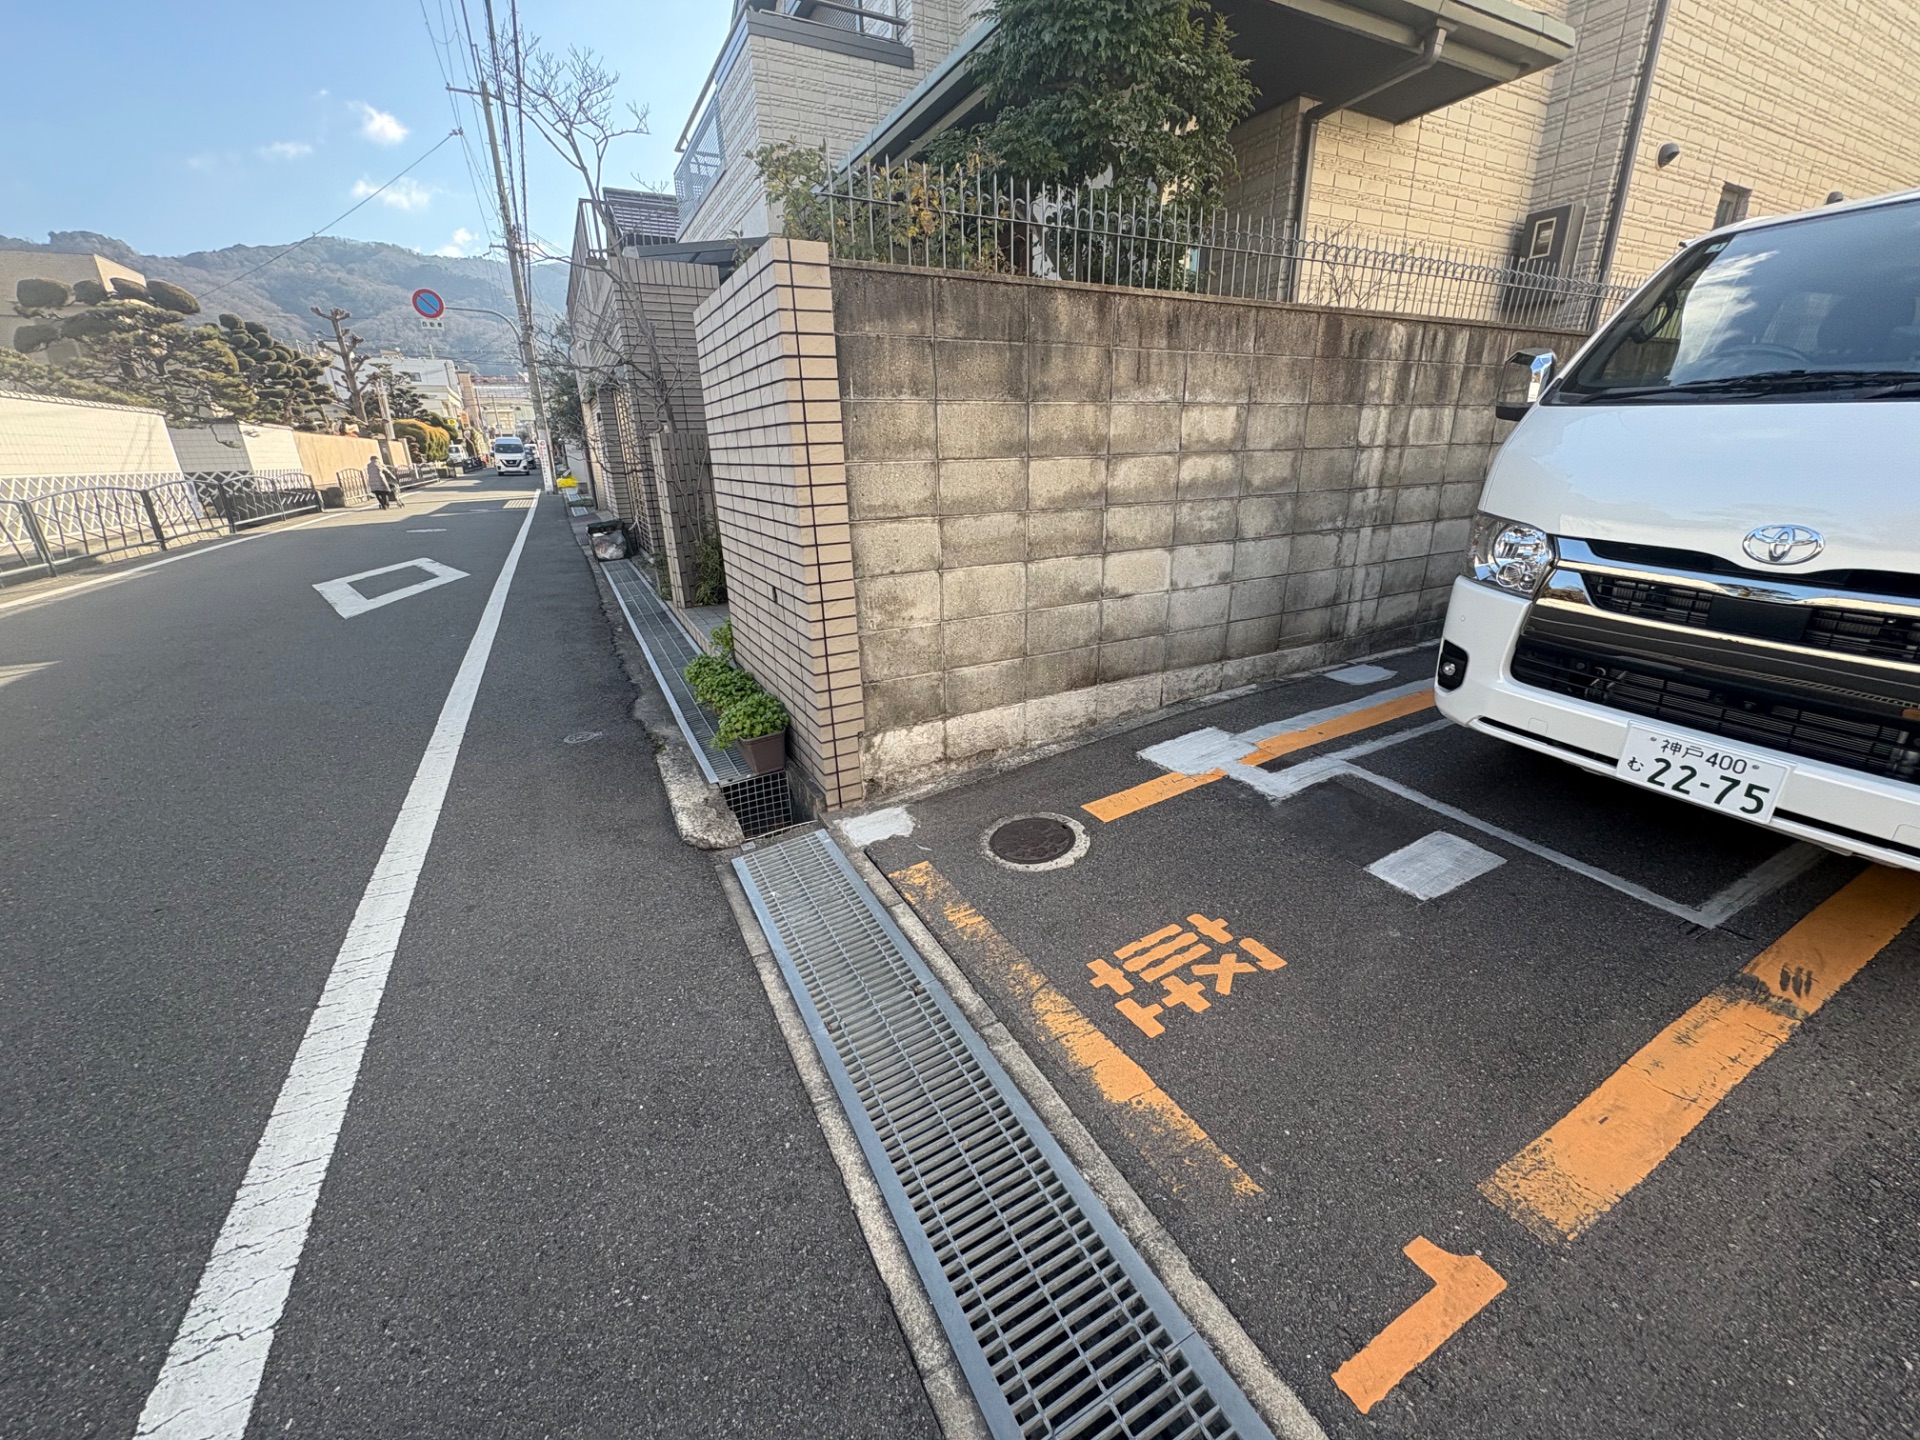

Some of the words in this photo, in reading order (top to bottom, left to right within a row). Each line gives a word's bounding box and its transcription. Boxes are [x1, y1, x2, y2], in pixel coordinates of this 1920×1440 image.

[1627, 756, 1644, 772] む
[1647, 757, 1770, 815] 22-75
[1660, 739, 1748, 774] 神戸400
[1086, 913, 1288, 1038] 軽
[1331, 1235, 1508, 1414] 1
